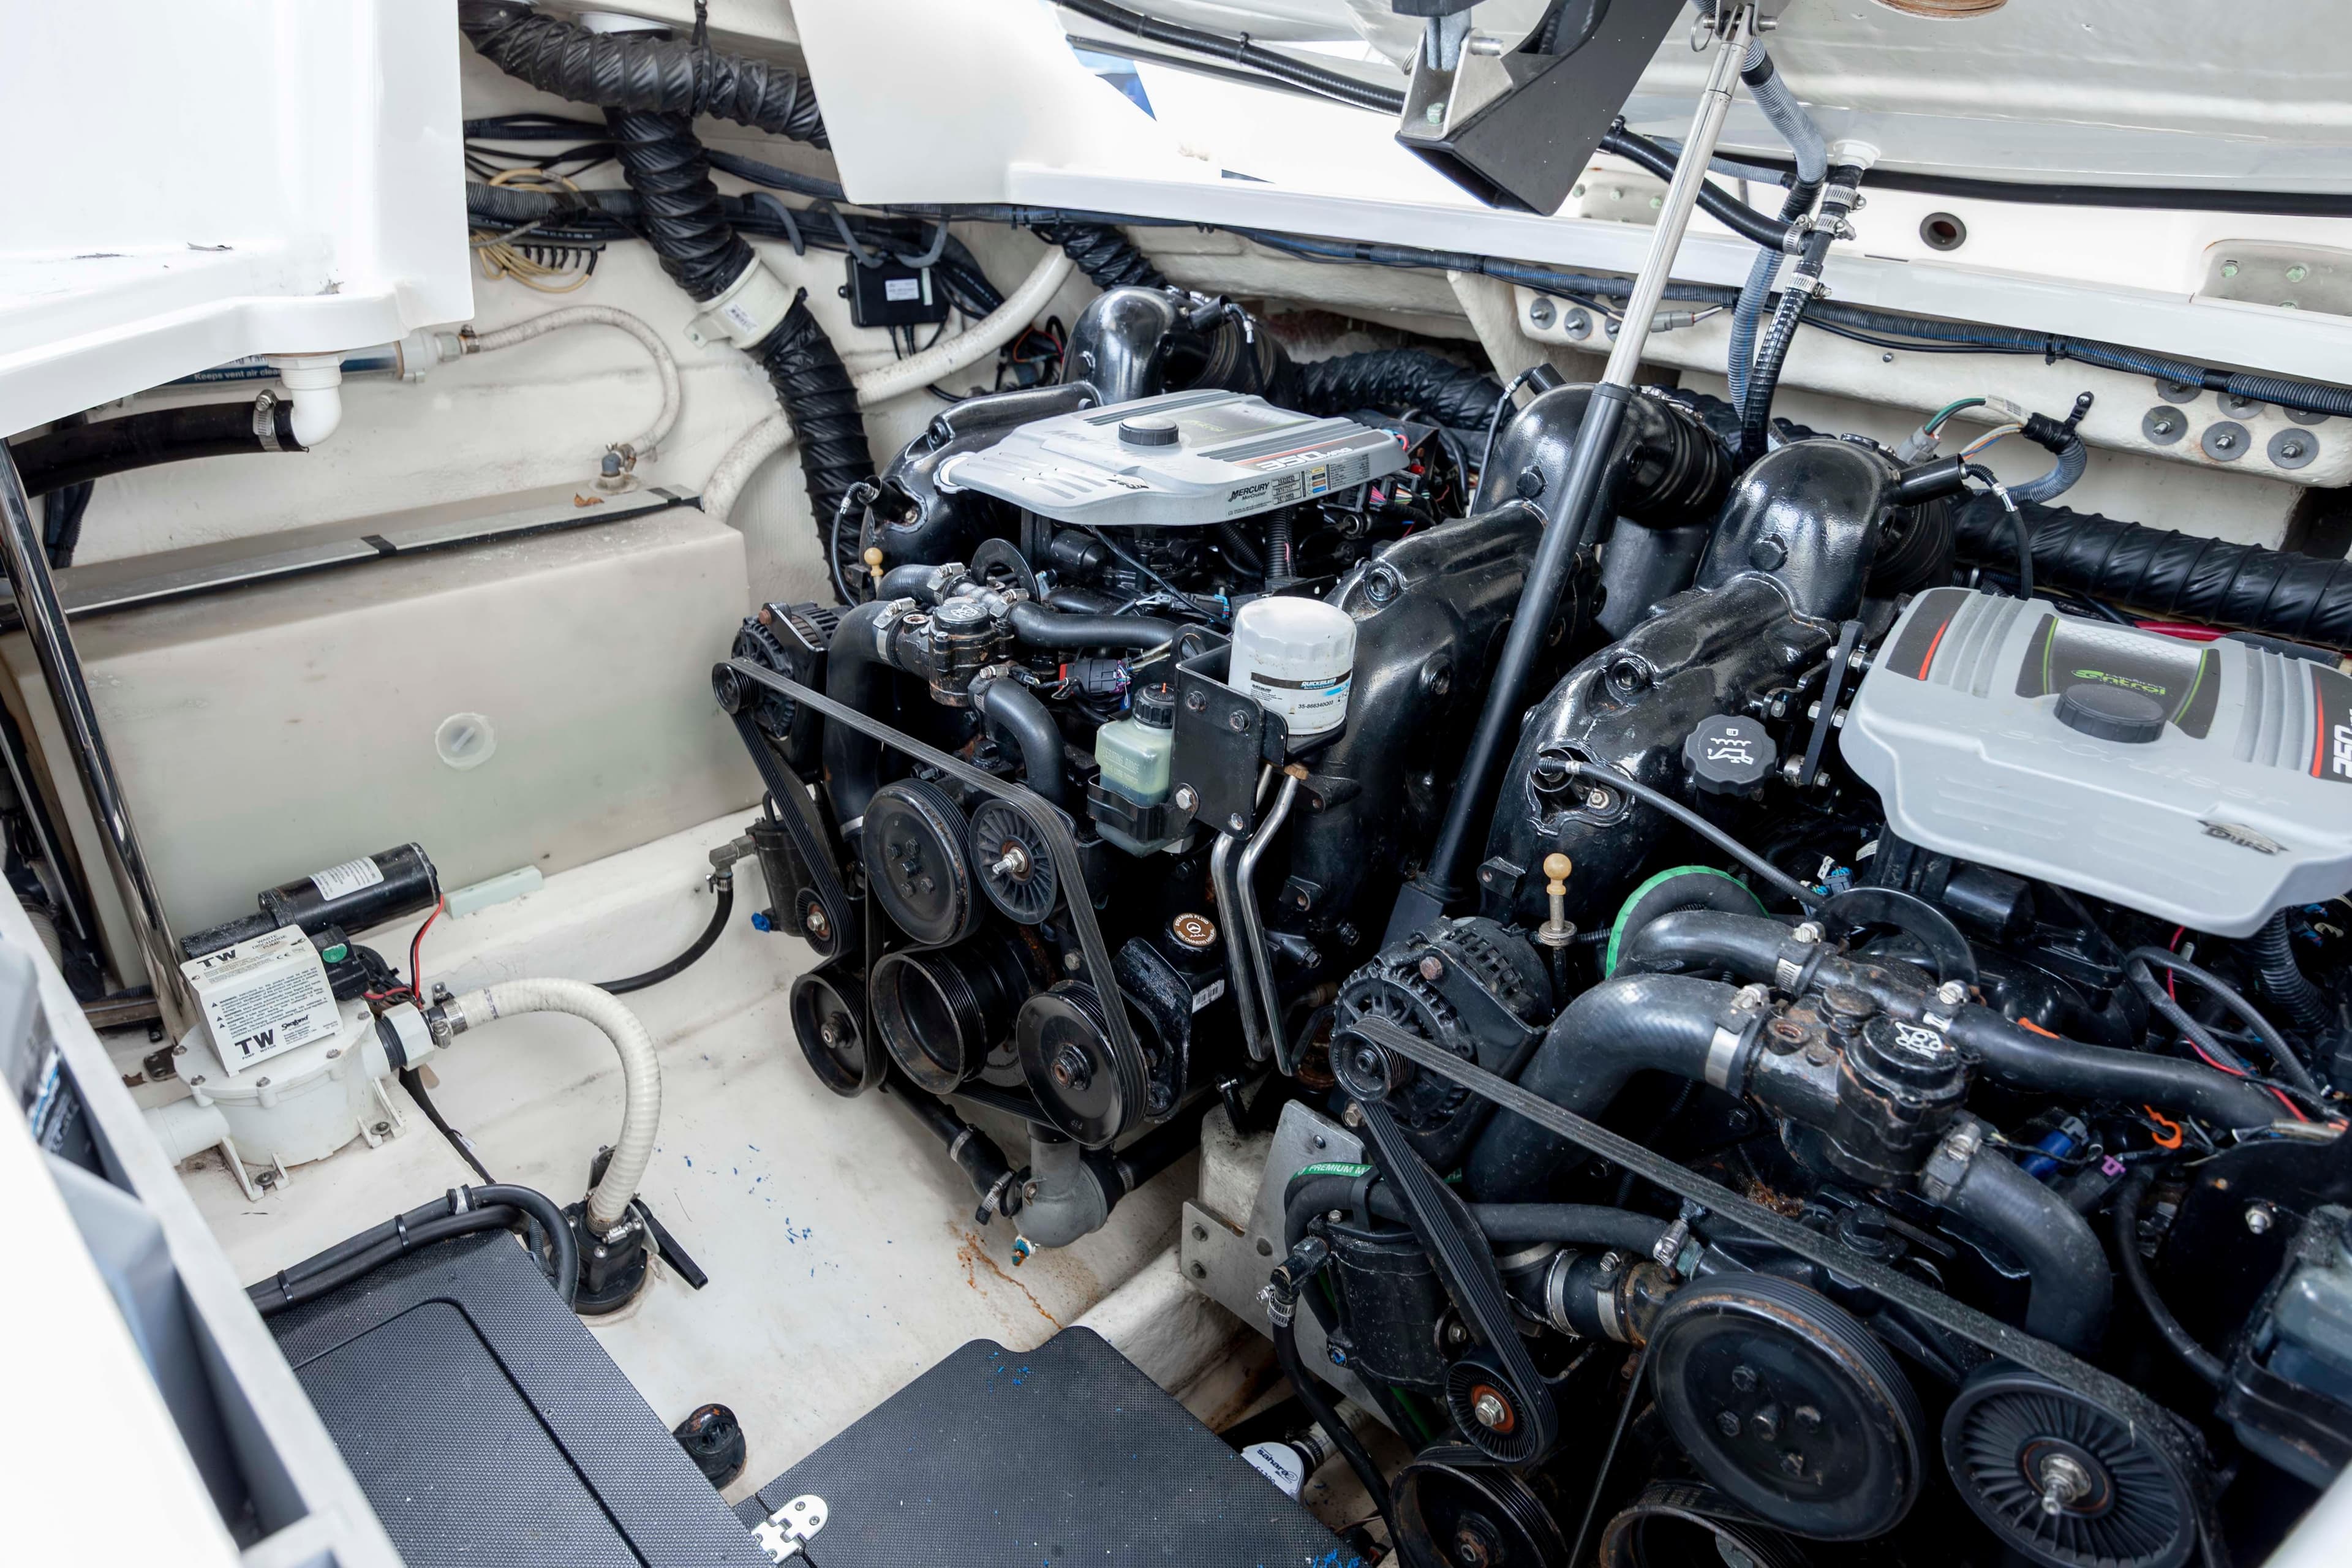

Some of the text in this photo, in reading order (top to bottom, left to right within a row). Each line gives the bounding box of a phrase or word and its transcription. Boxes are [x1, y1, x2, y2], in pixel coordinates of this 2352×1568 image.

[1256, 451, 1321, 471] 350
[1228, 481, 1270, 502] MERCURY
[1194, 914, 1209, 925] FLUID
[252, 935, 288, 949] DISCHARGE
[257, 935, 277, 943] WASTE
[197, 950, 236, 968] TW
[235, 1029, 274, 1055] TW
[1308, 1164, 1353, 1173] PREMIUM
